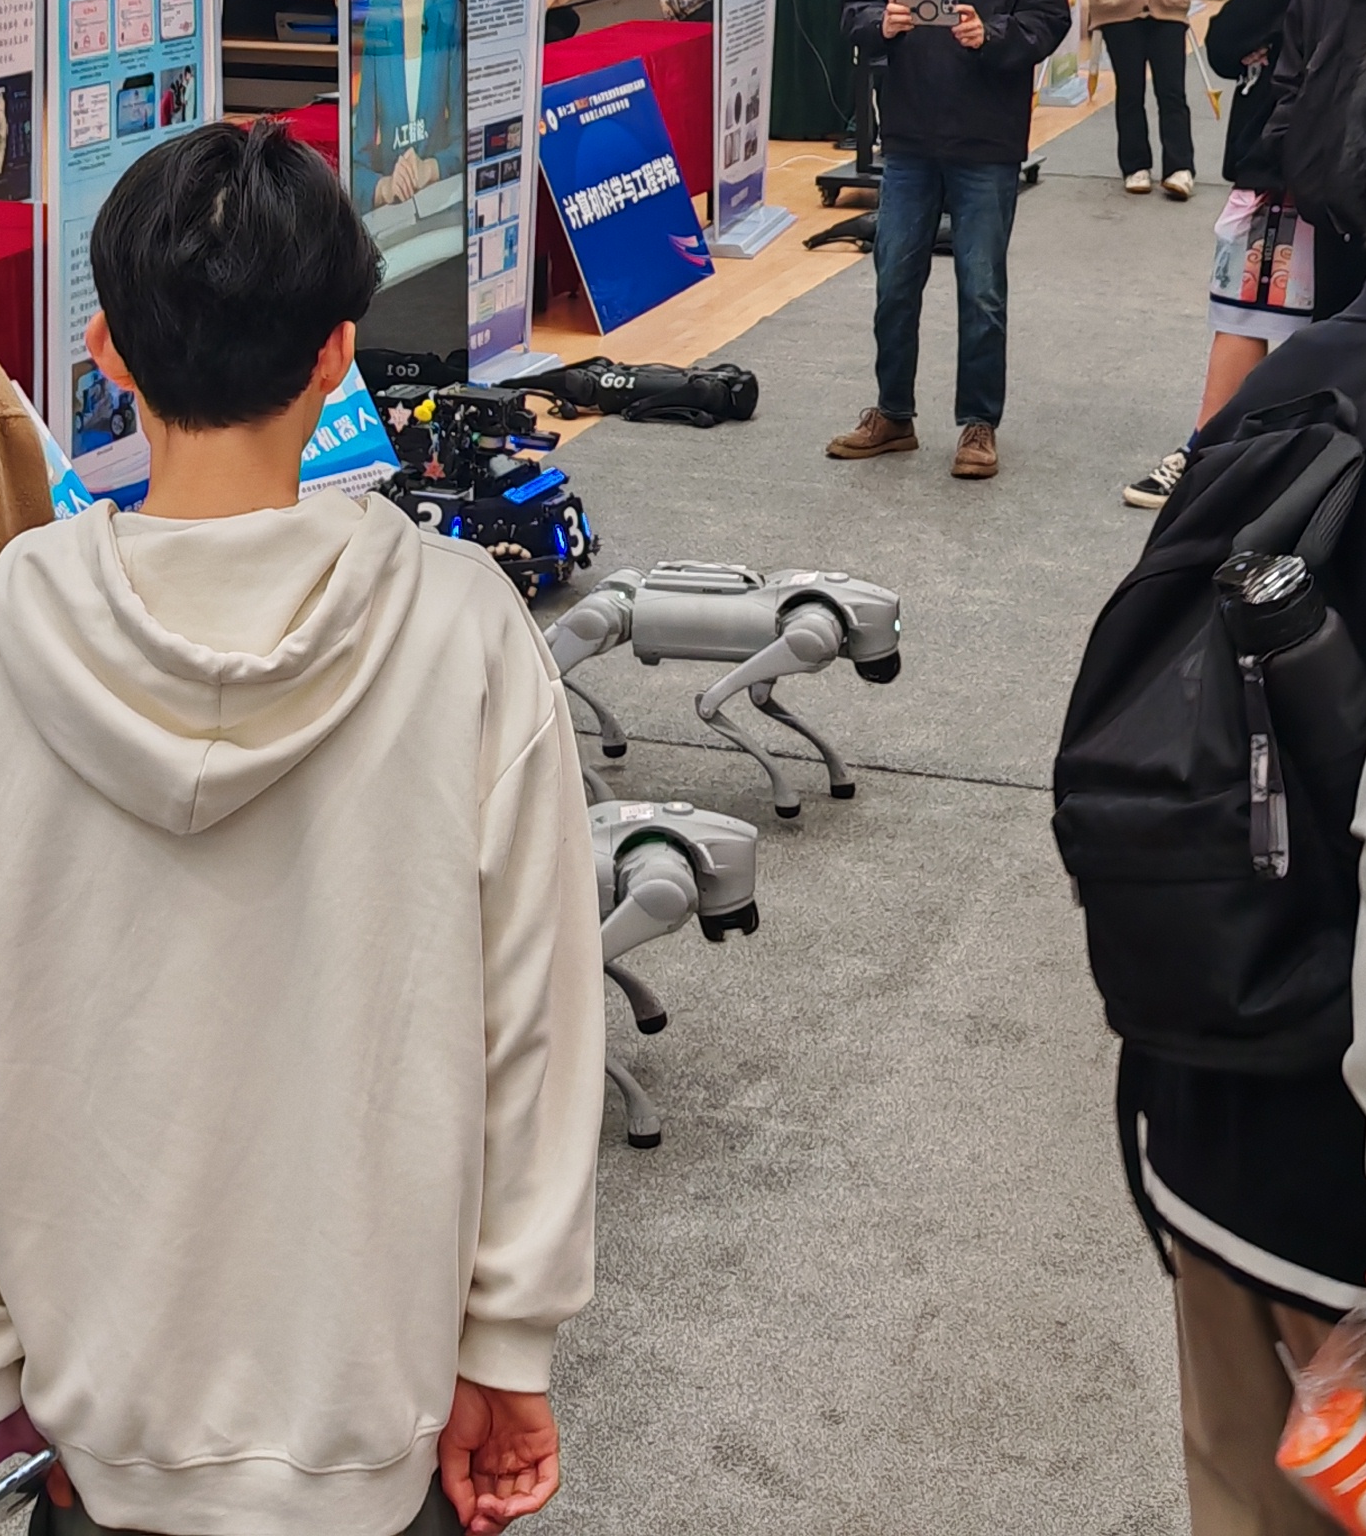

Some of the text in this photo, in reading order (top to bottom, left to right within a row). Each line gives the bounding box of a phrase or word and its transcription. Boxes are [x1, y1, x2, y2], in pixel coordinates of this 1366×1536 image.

[562, 153, 681, 231] 计算机科学与工程学院
[563, 506, 584, 557] 3
